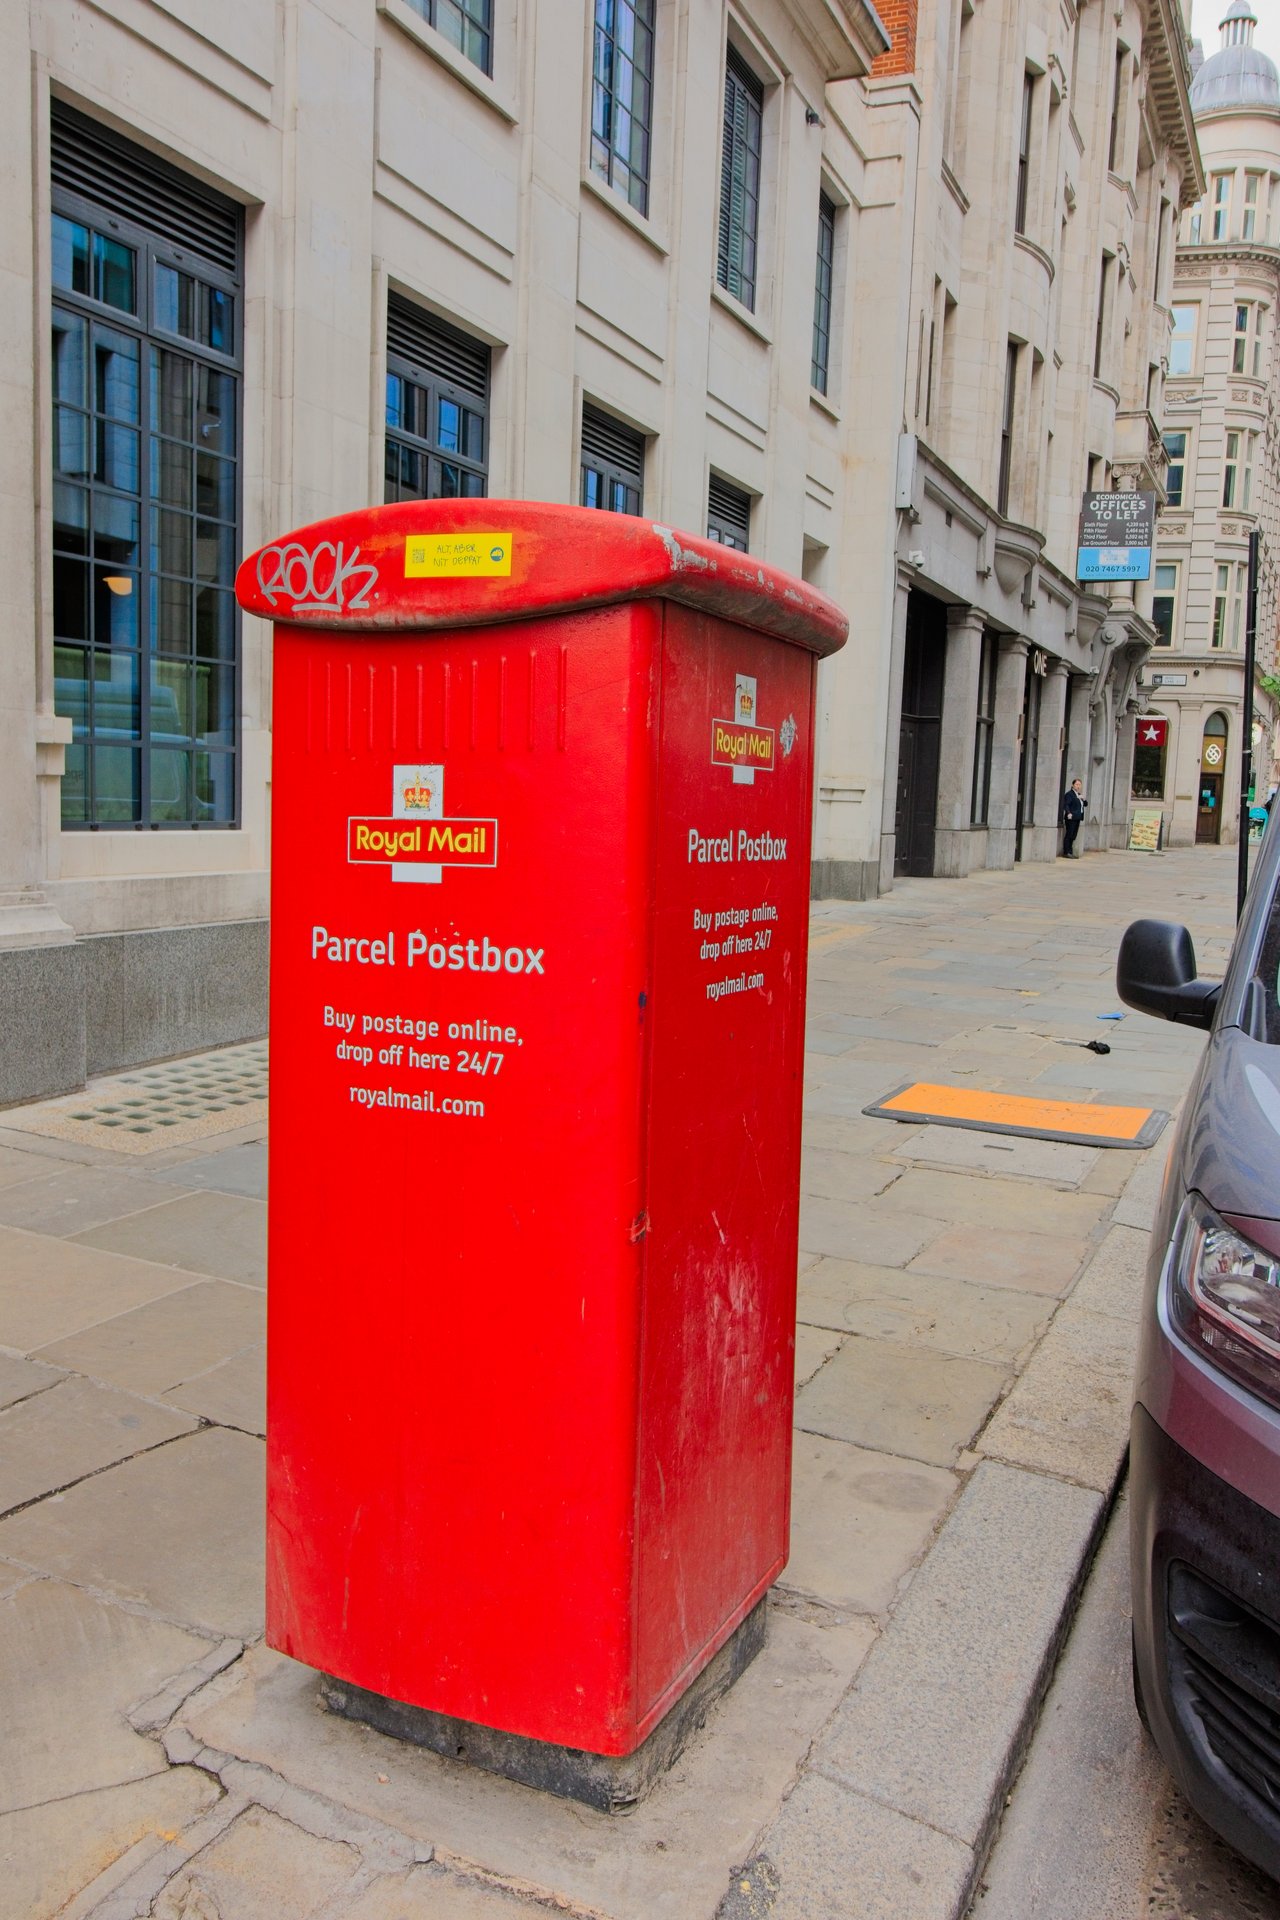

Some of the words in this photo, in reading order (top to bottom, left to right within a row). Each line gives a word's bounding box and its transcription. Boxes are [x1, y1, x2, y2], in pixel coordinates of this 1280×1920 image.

[1090, 500, 1146, 510] OFFICES
[1095, 511, 1112, 520] TO
[1116, 511, 1140, 520] LET
[454, 544, 476, 554] ABER
[716, 727, 747, 759] Royal
[748, 733, 771, 758] Mail
[356, 825, 421, 857] Royal
[428, 827, 486, 853] Mail
[688, 828, 733, 863] Parcel
[738, 829, 787, 862] Postbox
[693, 908, 713, 933] Buy
[714, 907, 749, 931] postage
[751, 902, 778, 922] online,
[312, 926, 395, 966] Parcel
[407, 931, 544, 975] Postbox
[700, 939, 720, 962] drop
[721, 935, 734, 956] off
[735, 934, 753, 953] here
[754, 929, 772, 951] 24/7
[706, 972, 764, 1001] royalmail.com
[323, 1005, 356, 1033] Buy
[362, 1014, 439, 1040] postage
[448, 1019, 523, 1046] online,
[336, 1039, 373, 1066] drop
[378, 1044, 404, 1066] off
[408, 1047, 450, 1071] here
[456, 1050, 505, 1076] 24/7
[349, 1086, 485, 1117] royalmail.com
